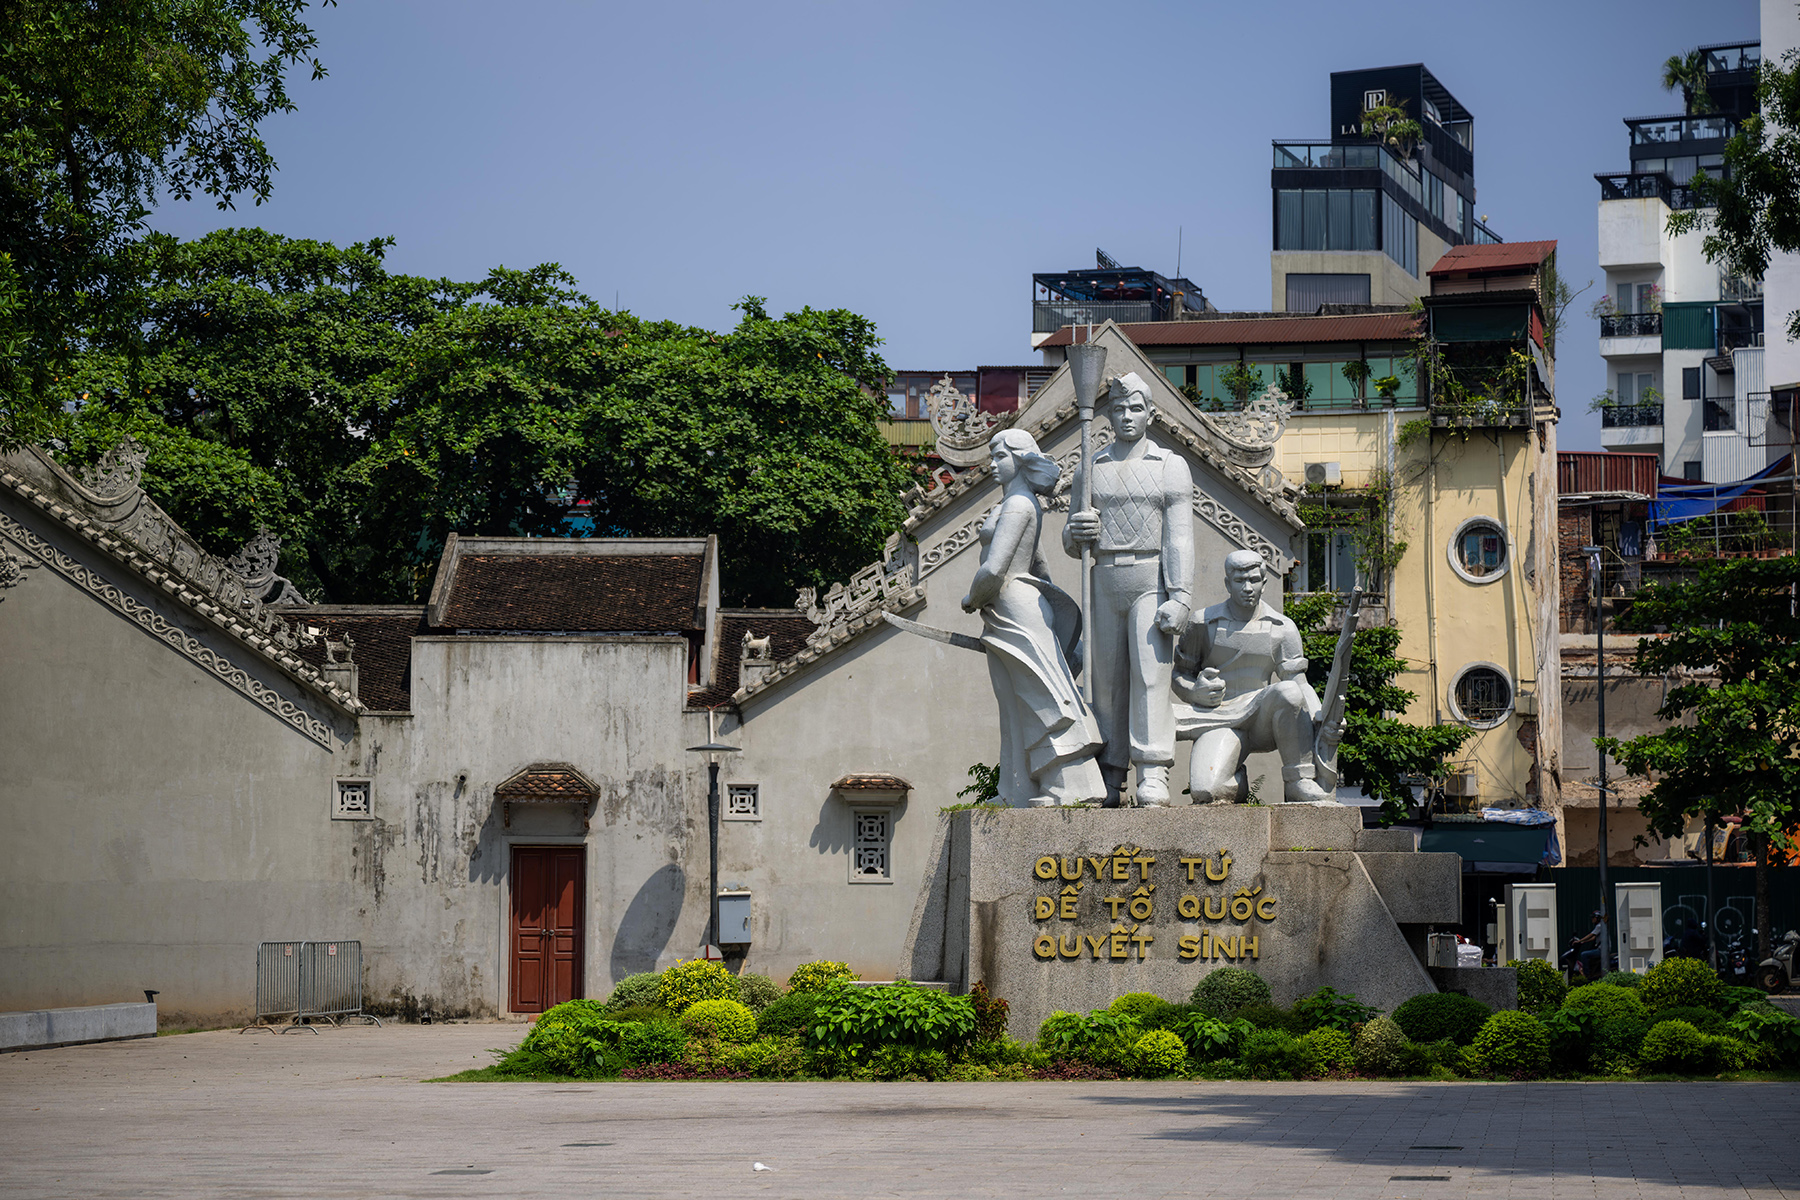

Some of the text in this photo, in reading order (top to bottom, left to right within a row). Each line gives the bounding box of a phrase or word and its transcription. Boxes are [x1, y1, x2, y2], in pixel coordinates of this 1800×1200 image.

[1341, 123, 1357, 135] LA
[1034, 846, 1233, 881] QUYẾT TỬ
[1034, 882, 1277, 921] ĐỂ TỔ QUỐC
[1033, 924, 1154, 959] QUYẾT
